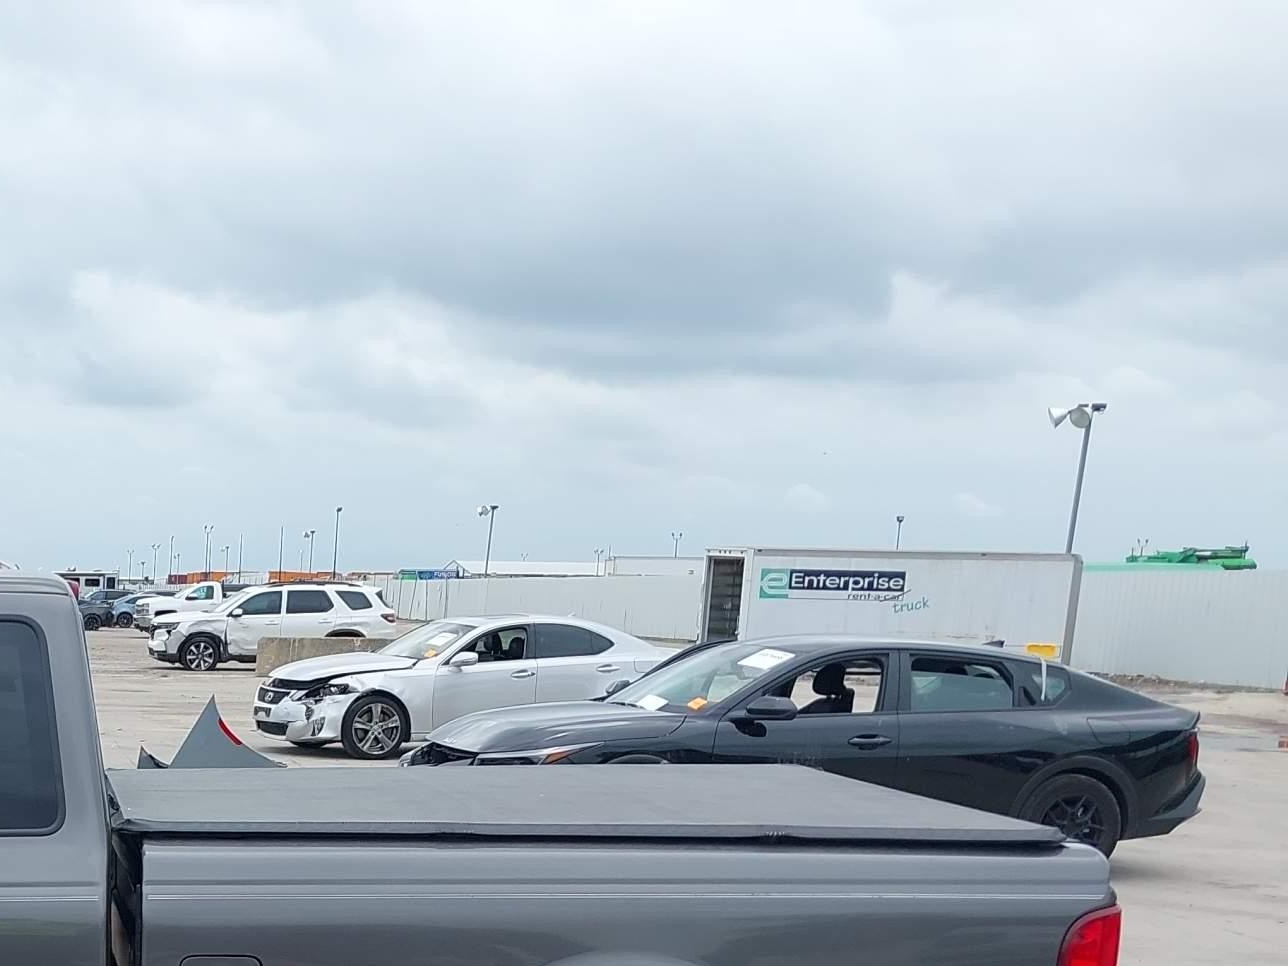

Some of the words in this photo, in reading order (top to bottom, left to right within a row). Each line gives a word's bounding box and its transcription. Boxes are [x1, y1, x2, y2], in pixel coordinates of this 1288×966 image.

[791, 573, 904, 592] Enterprise
[847, 592, 905, 601] rent-a-car
[893, 597, 929, 613] truck
